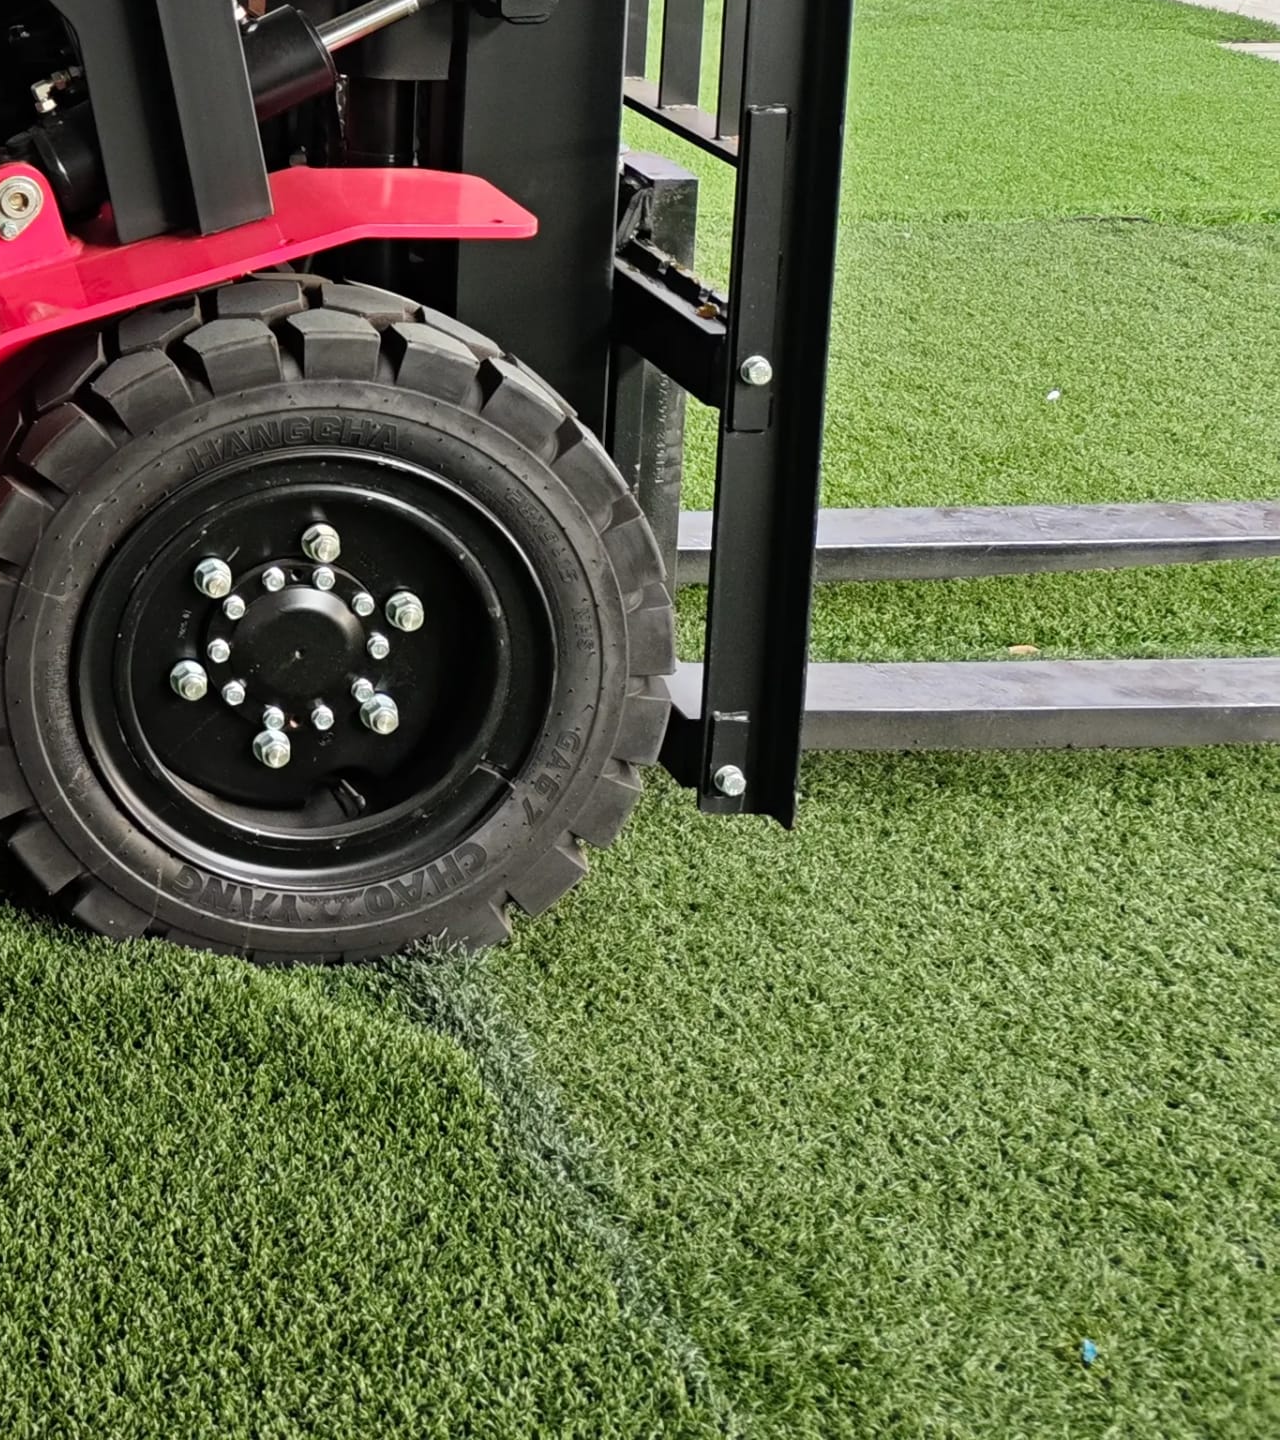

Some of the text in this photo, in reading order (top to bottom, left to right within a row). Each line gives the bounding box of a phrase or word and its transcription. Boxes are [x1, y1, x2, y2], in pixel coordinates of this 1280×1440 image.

[187, 416, 401, 472] HANGCHA
[171, 842, 487, 922] CHAO YANG
